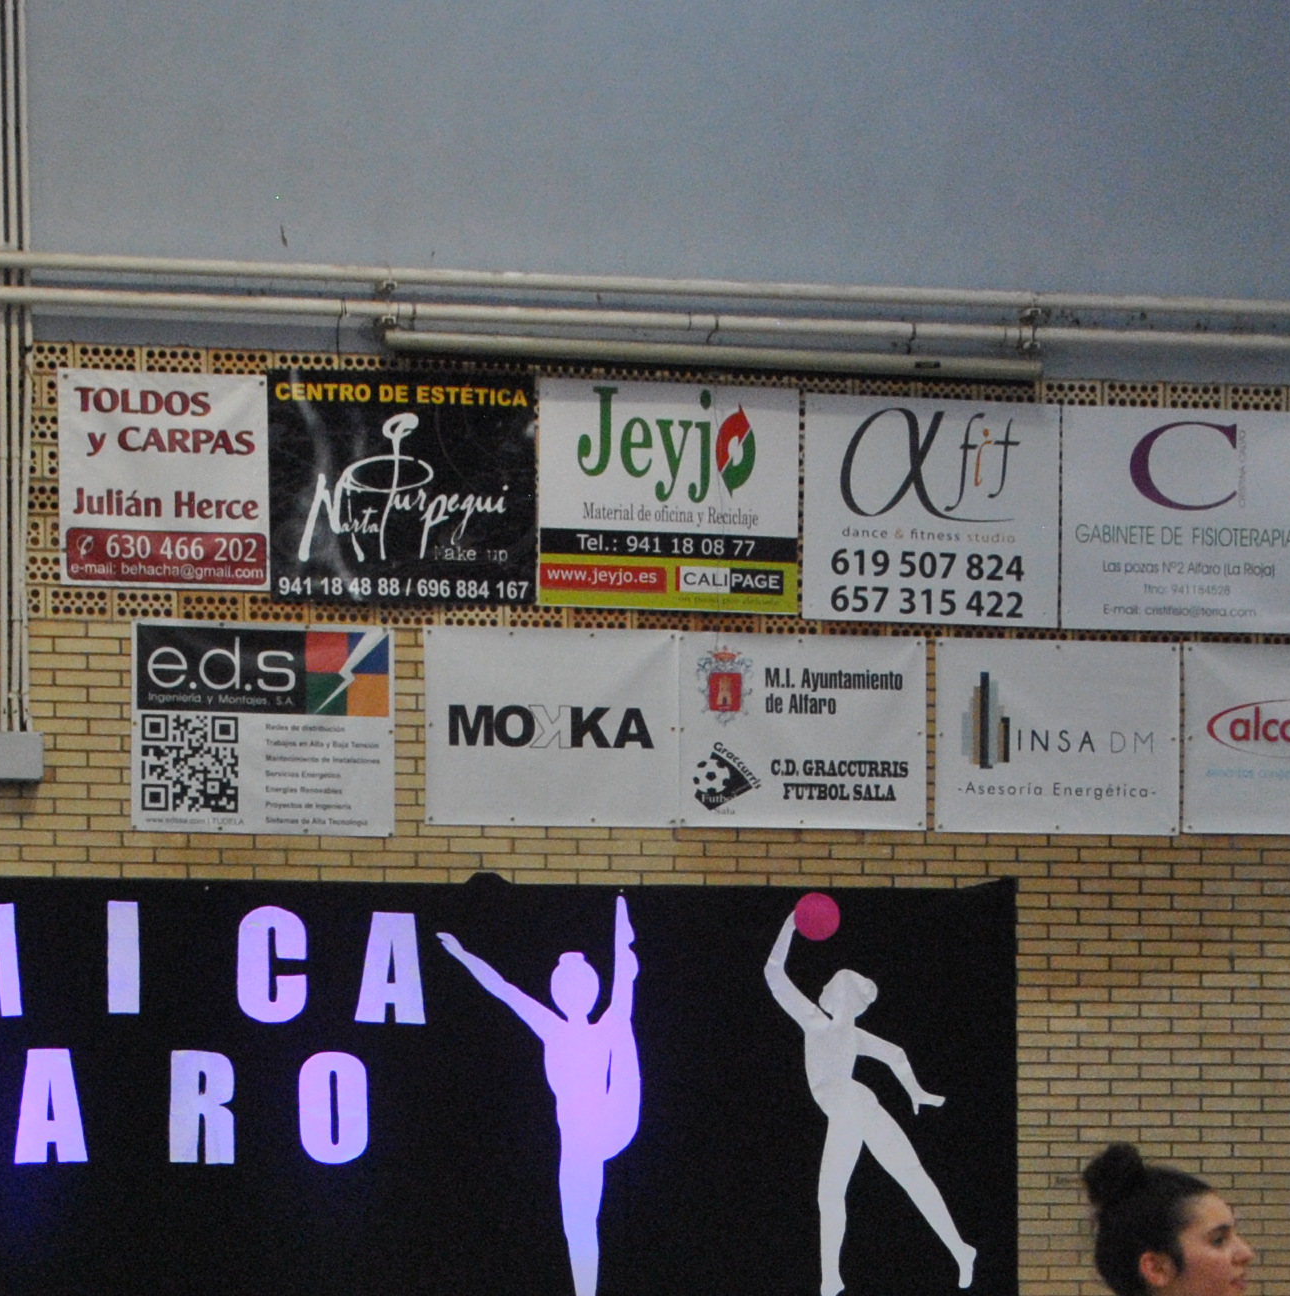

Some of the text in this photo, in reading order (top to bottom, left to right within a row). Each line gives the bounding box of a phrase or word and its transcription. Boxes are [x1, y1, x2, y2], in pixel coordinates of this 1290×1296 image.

[74, 387, 211, 416] TOLDOS
[275, 382, 527, 406] CENTRO DE ESTÉTICA
[87, 427, 256, 457] y CARPAS
[578, 386, 756, 503] Jeyjo
[73, 488, 258, 520] Julián Herce
[583, 502, 758, 529] Material de oficina y Reciclaje
[577, 534, 755, 556] Tel.: 941 18 08 77
[842, 527, 1016, 544] dance & fitness studio
[1075, 524, 1154, 545] GABINETE
[1161, 526, 1182, 545] DE
[107, 534, 257, 562] 630 466 202
[71, 563, 263, 579] e-mail: behacha@gmail.com
[831, 549, 1024, 581] 619 507 824
[1103, 561, 1121, 573] Las
[1124, 563, 1159, 574] pozas
[1188, 562, 1220, 575] Alfaro
[1224, 563, 1240, 576] (La
[548, 569, 657, 584] www.jeyjo.es
[279, 577, 528, 599] 941 18 48 88 696 884 167
[831, 586, 1023, 618] 657 315 422
[148, 637, 295, 692] e.d.s
[765, 668, 903, 692] M.I. Ayuntamiento
[207, 695, 213, 705] y
[765, 694, 836, 714] de Alfaro
[266, 739, 297, 747] Trabajos
[1017, 730, 1154, 753] INSA DM
[713, 742, 761, 790] Graccurris
[771, 759, 908, 778] C.D. GRACCURRIS
[300, 786, 342, 794] Renovables
[783, 783, 896, 801] FUTBOL SALA
[265, 801, 302, 809] Proyectos
